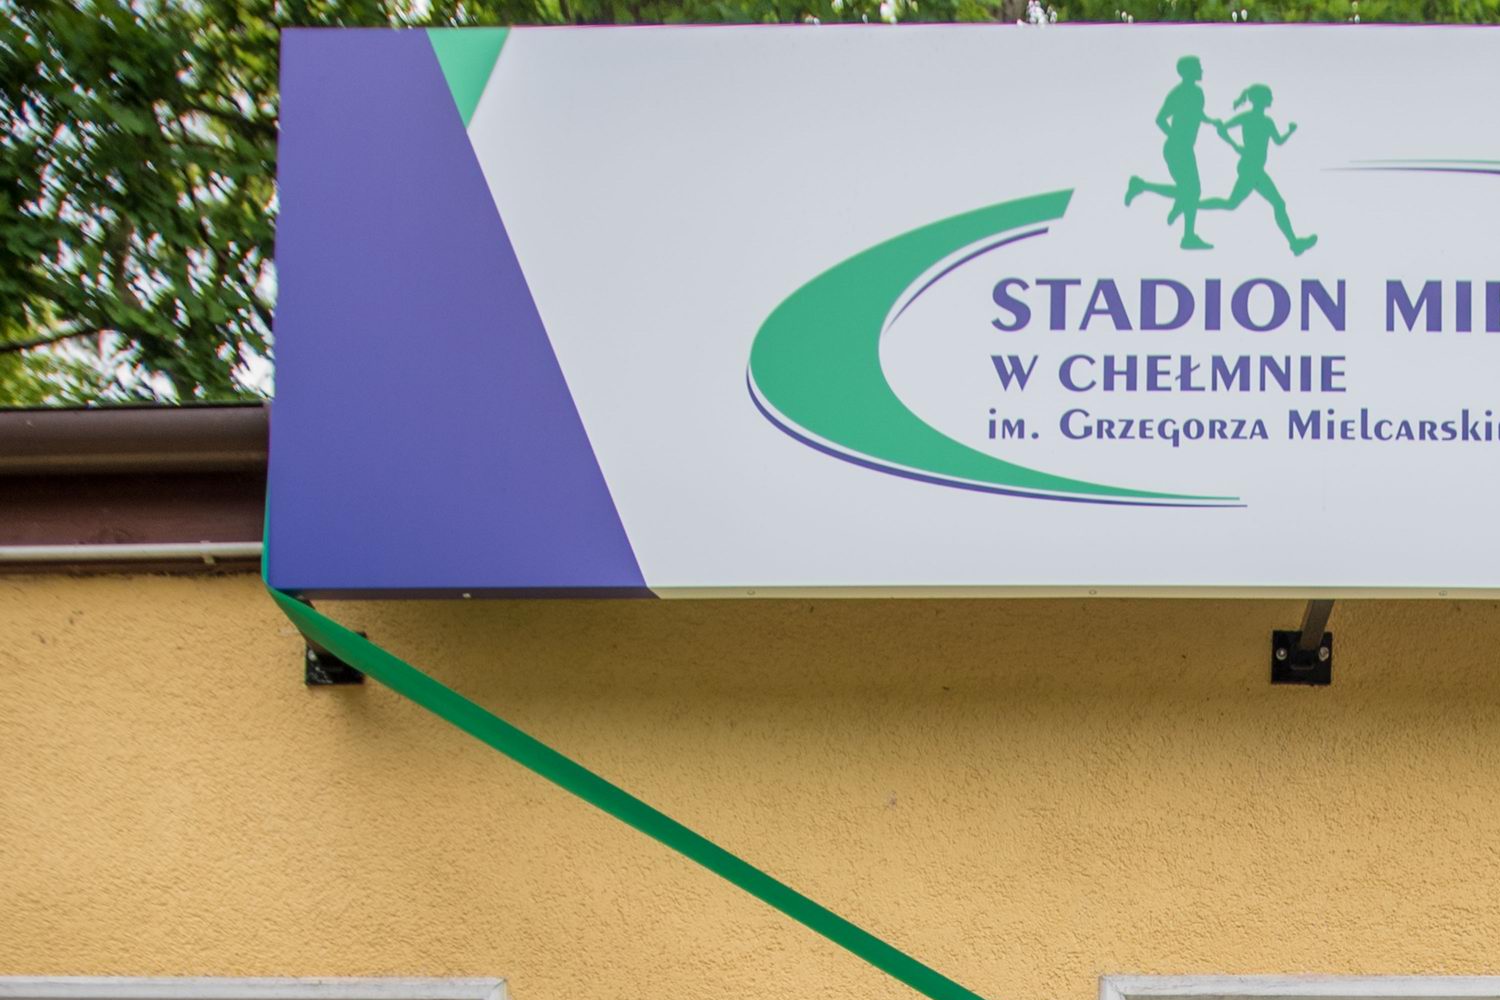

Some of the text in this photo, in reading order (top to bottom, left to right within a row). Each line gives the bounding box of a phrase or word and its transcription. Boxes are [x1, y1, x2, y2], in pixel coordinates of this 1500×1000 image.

[990, 277, 1347, 333] STADION
[990, 354, 1348, 393] W CHEŁMNIE
